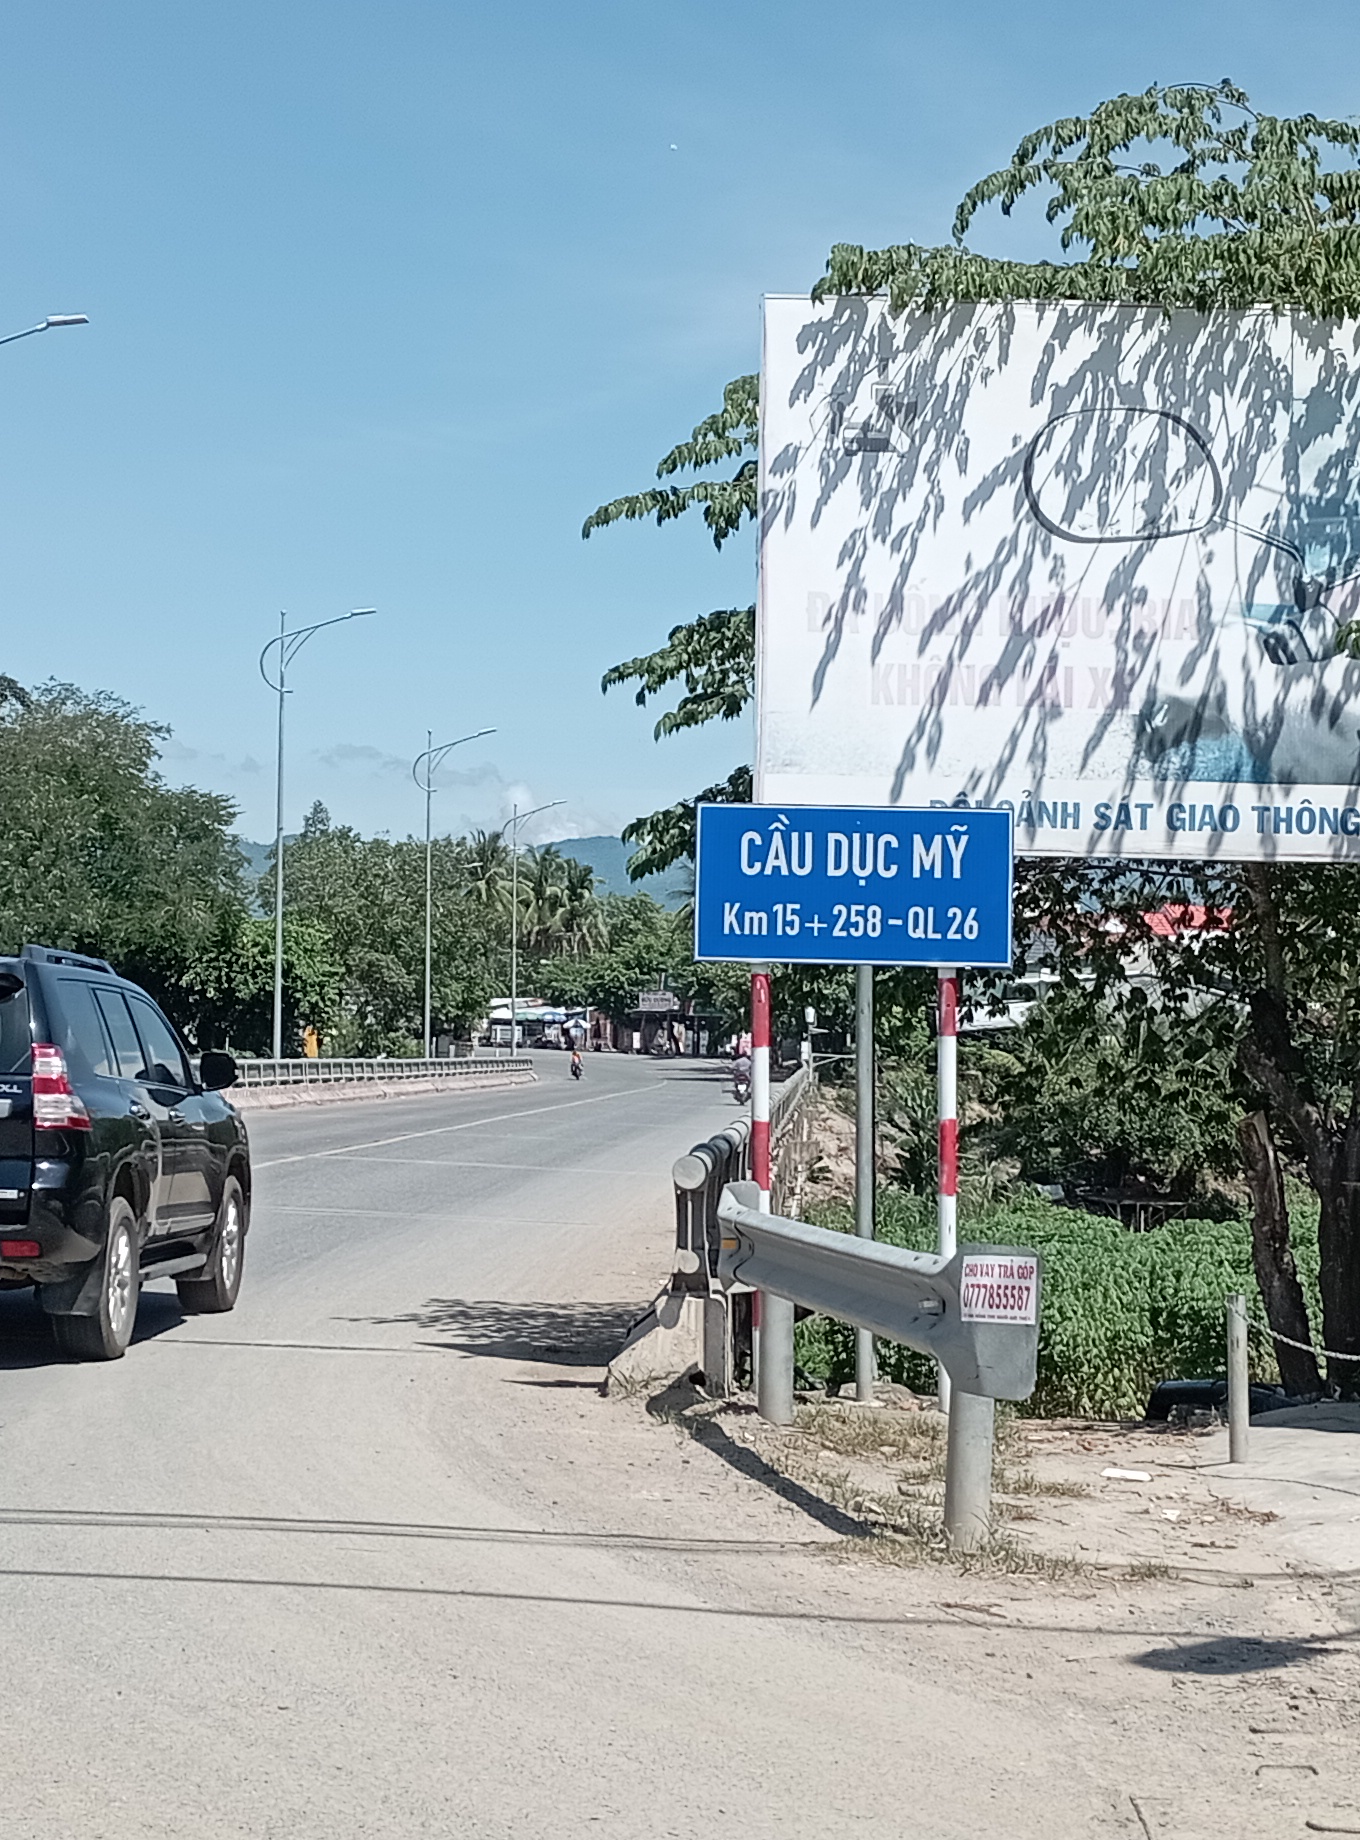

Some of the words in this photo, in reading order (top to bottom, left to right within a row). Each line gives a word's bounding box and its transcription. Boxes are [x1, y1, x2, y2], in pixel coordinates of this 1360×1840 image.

[997, 789, 1081, 831] ẢNH
[1093, 795, 1153, 831] SÁT
[1166, 803, 1240, 833] GIAO
[1251, 799, 1360, 837] THÔNG
[740, 814, 813, 876] CẦU
[827, 832, 899, 886] DỤC
[912, 824, 969, 879] MỸ
[964, 1263, 978, 1277] CHO
[980, 1263, 995, 1278] VAY
[998, 1259, 1015, 1279] TRẢ
[1017, 1261, 1035, 1280] GÓP
[963, 1283, 1031, 1311] 0777855587
